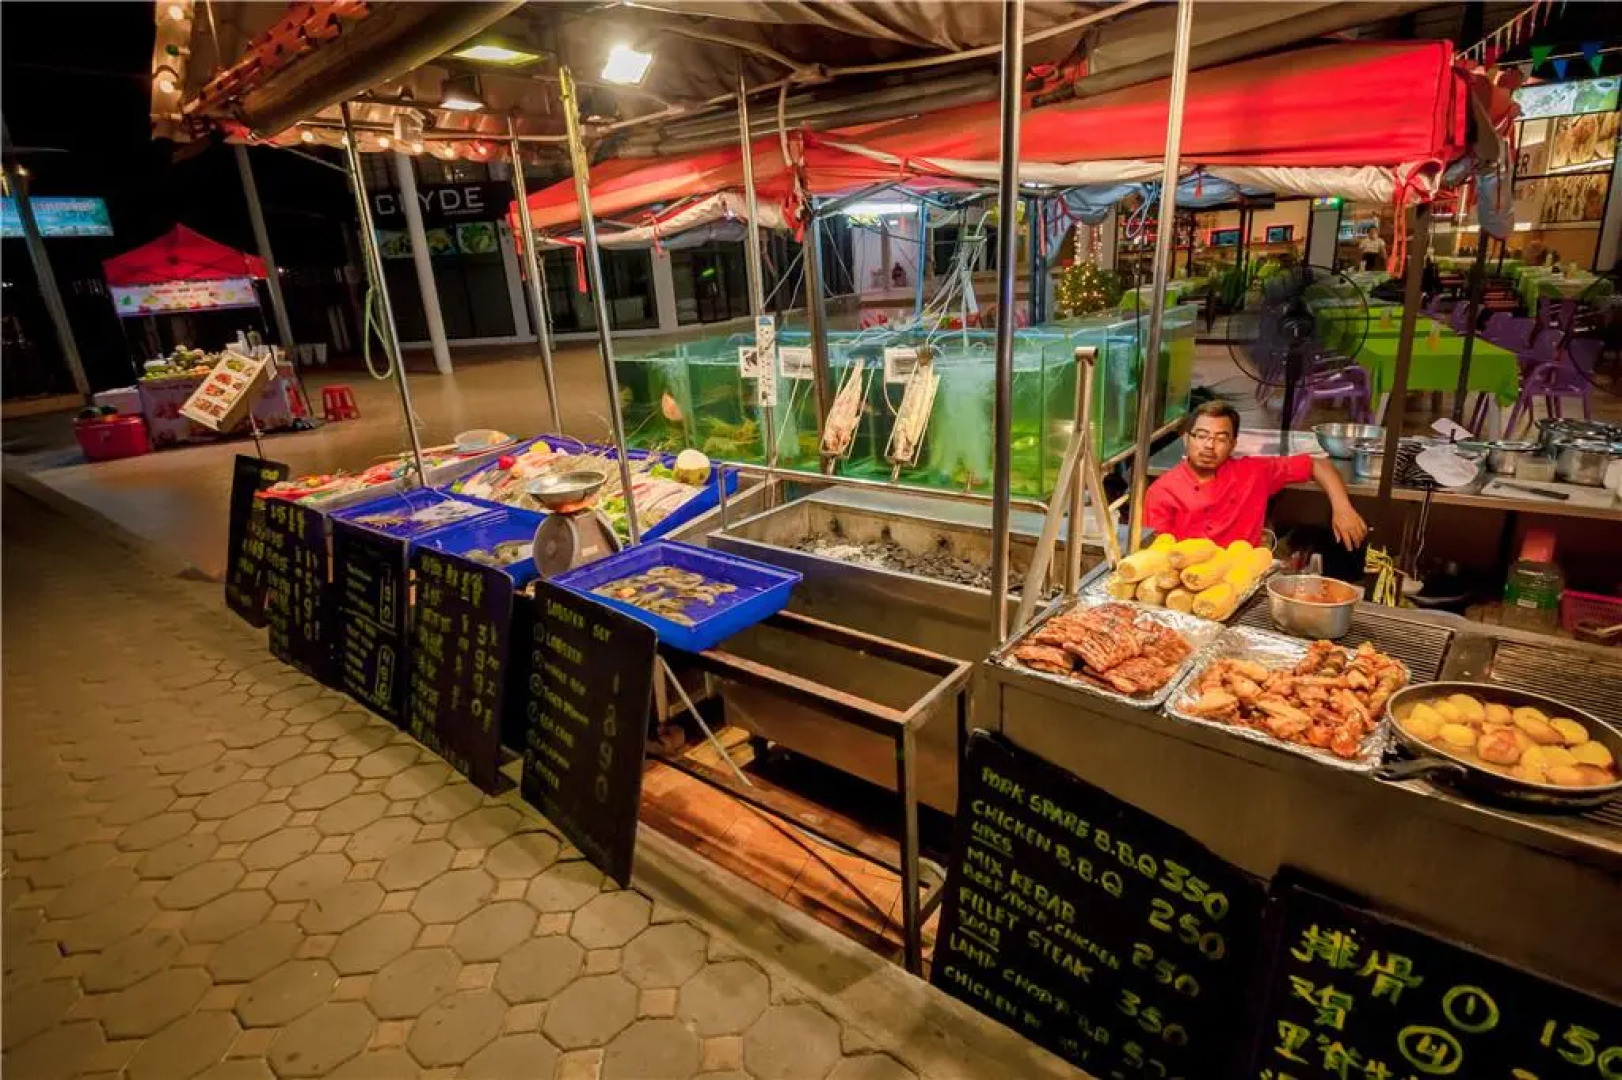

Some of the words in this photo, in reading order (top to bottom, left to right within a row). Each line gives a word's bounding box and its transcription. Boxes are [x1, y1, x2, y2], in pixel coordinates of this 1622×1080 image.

[375, 186, 484, 215] CYDE
[967, 846, 1003, 877] MIX
[971, 800, 1051, 853] CHICKEN
[1148, 898, 1225, 961] 250
[982, 766, 1024, 804] PORK
[1029, 795, 1090, 838] SPARE
[1159, 858, 1229, 922] 350
[960, 887, 1020, 931] FILLET
[1028, 929, 1094, 985] STEAK
